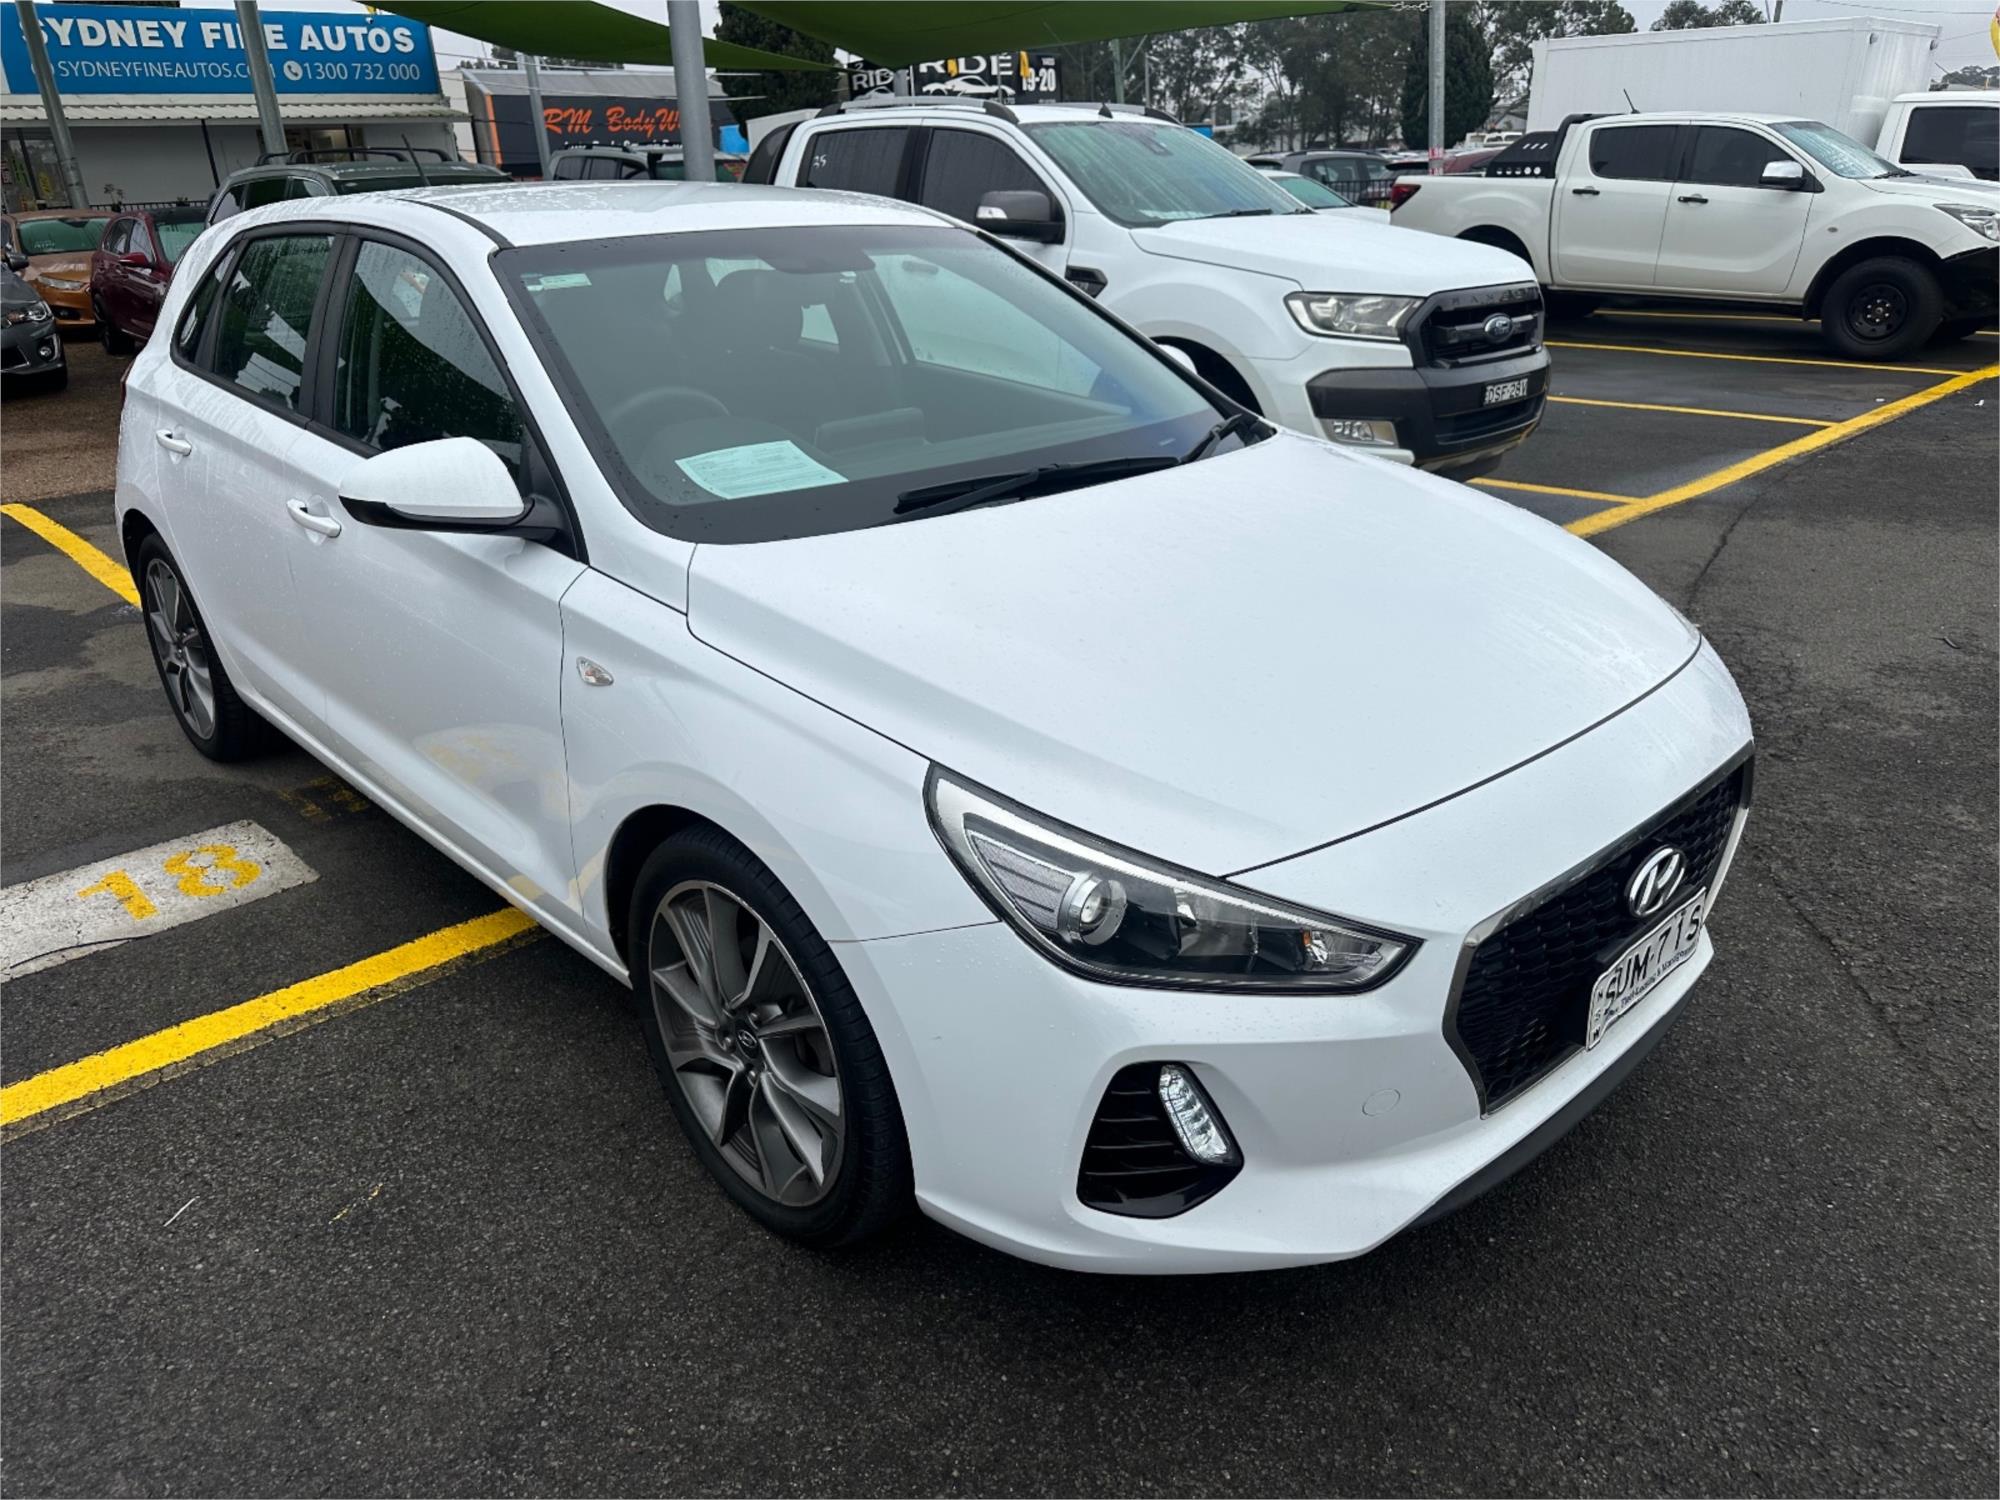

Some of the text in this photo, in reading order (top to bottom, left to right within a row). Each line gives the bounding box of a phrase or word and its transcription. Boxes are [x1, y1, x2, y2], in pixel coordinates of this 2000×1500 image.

[200, 22, 288, 50] FIE
[300, 25, 415, 54] AUTOS
[57, 60, 420, 81] SYDNEYFINEAUTOS.C 1300 732 000
[852, 68, 910, 91] RID
[544, 106, 681, 138] RM BodyW
[77, 843, 261, 921] 18
